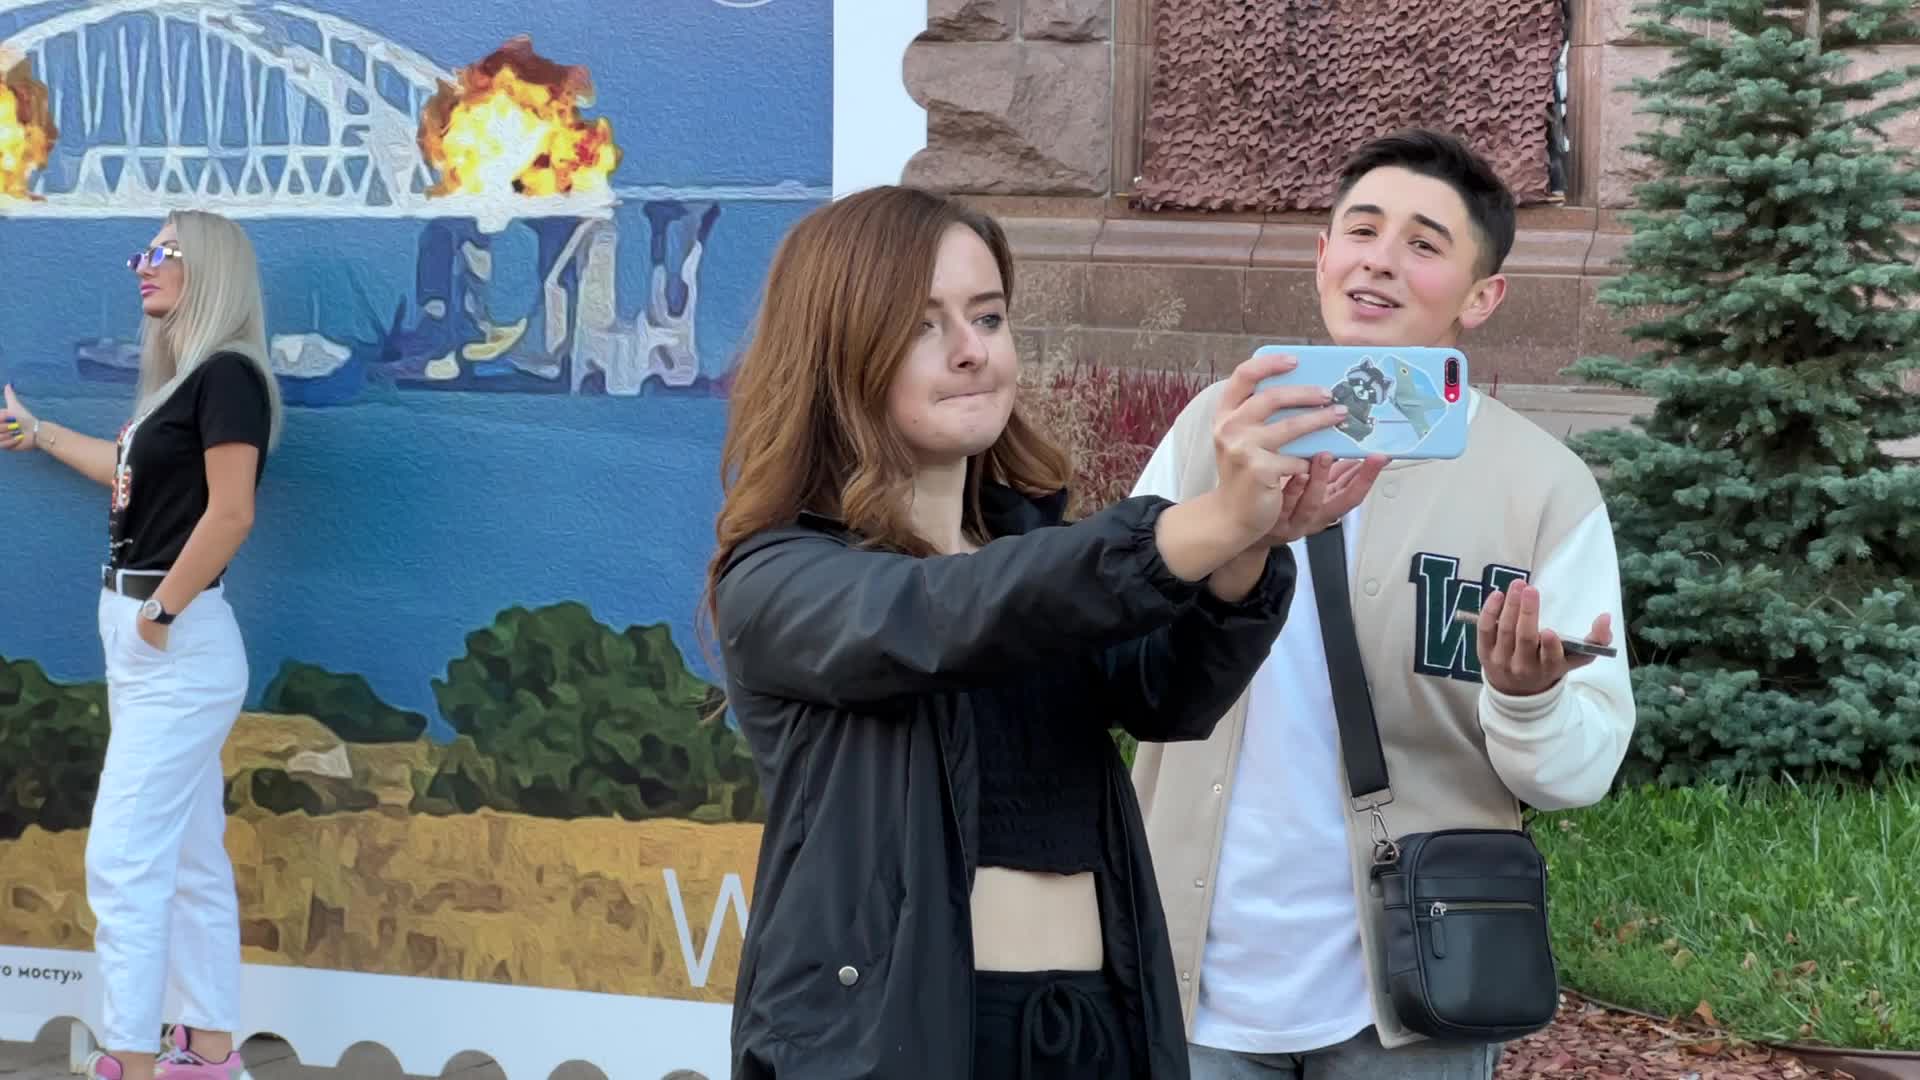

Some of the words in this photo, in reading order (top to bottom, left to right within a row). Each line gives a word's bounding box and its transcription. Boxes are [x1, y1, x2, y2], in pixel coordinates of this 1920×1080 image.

[1409, 552, 1530, 683] W
[0, 965, 12, 977] о
[18, 967, 83, 984] мосту»
[662, 868, 750, 988] W
